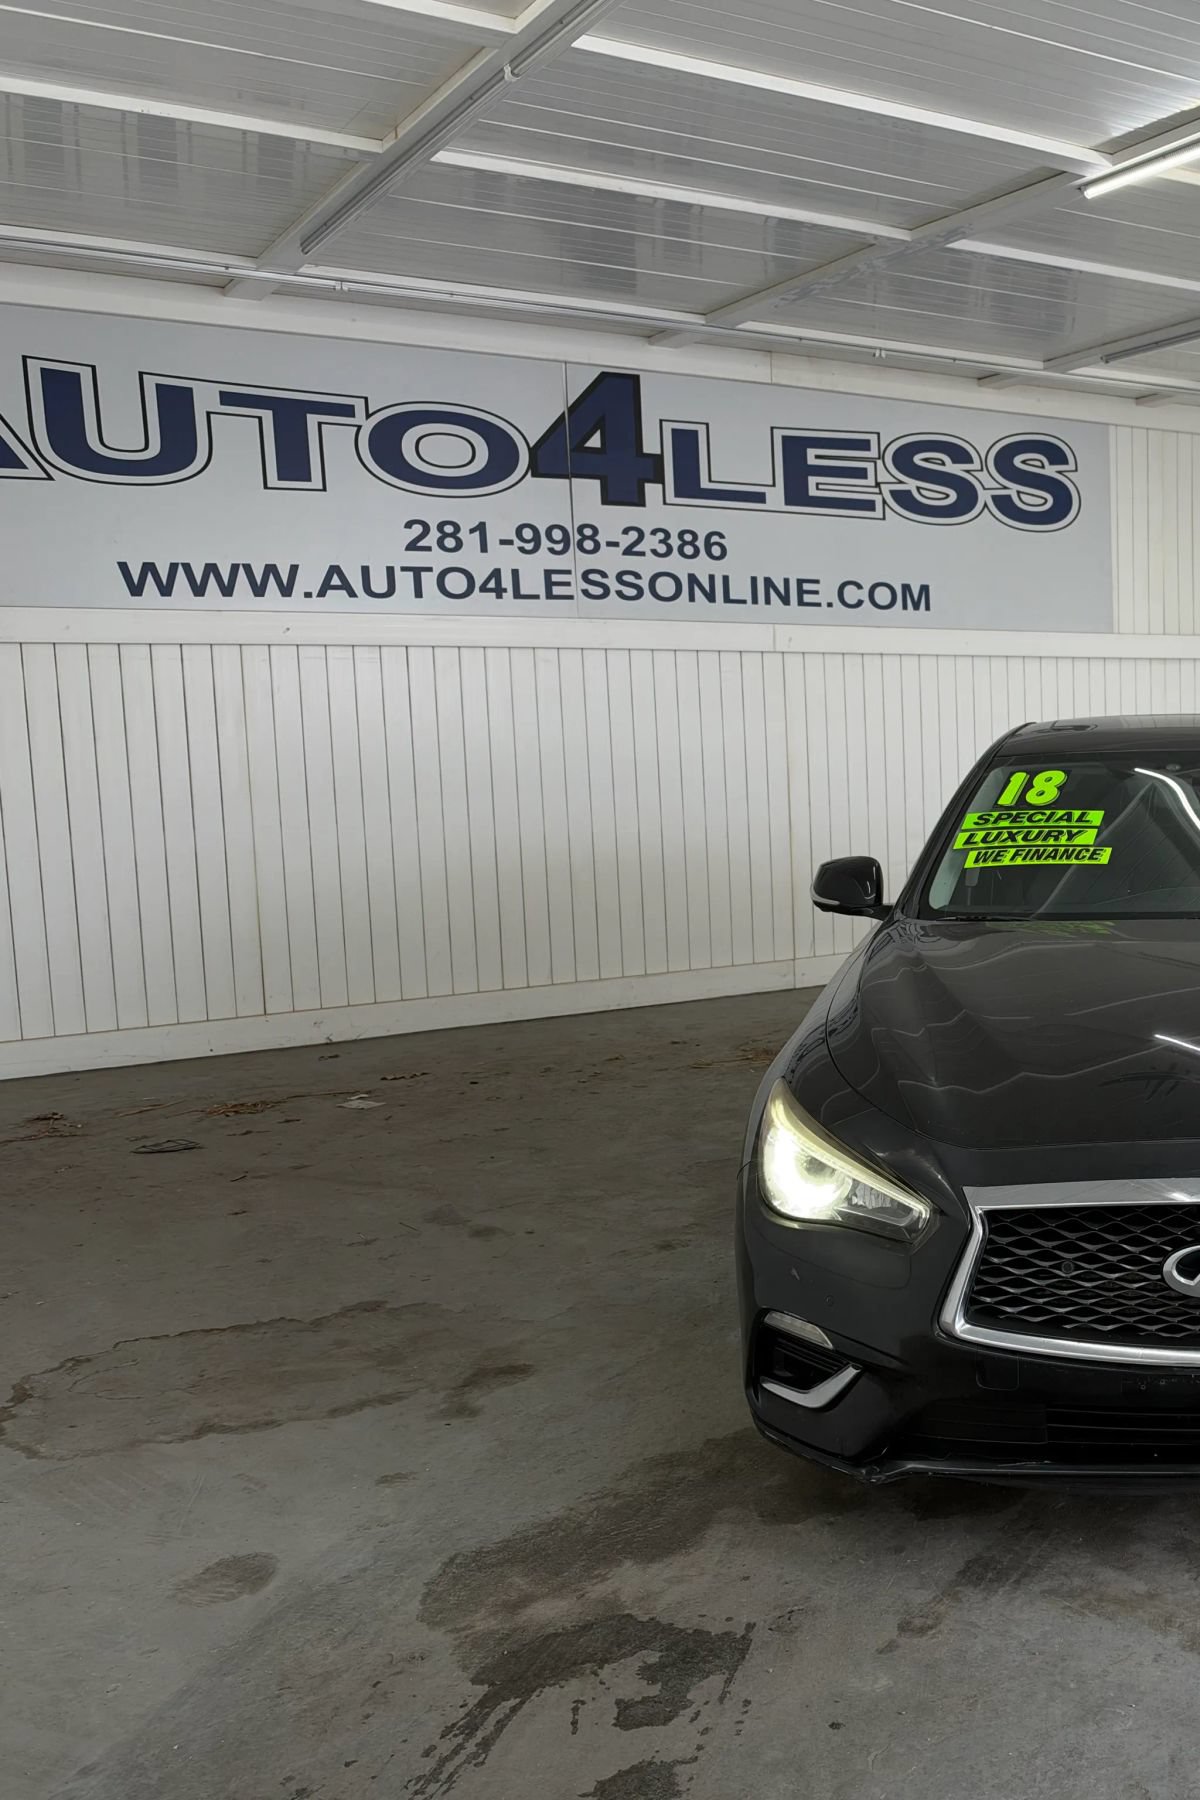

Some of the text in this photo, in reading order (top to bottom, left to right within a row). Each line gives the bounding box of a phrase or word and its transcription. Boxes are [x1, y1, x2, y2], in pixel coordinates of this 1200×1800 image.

[403, 518, 728, 561] 281-998-2386
[117, 561, 932, 612] WWW.AUTO4LESSONLINE.COM
[997, 769, 1068, 806] 18
[973, 811, 1093, 826] SPECIAL
[962, 829, 1088, 847] LUXURY
[972, 848, 1105, 865] WE FINANCE
